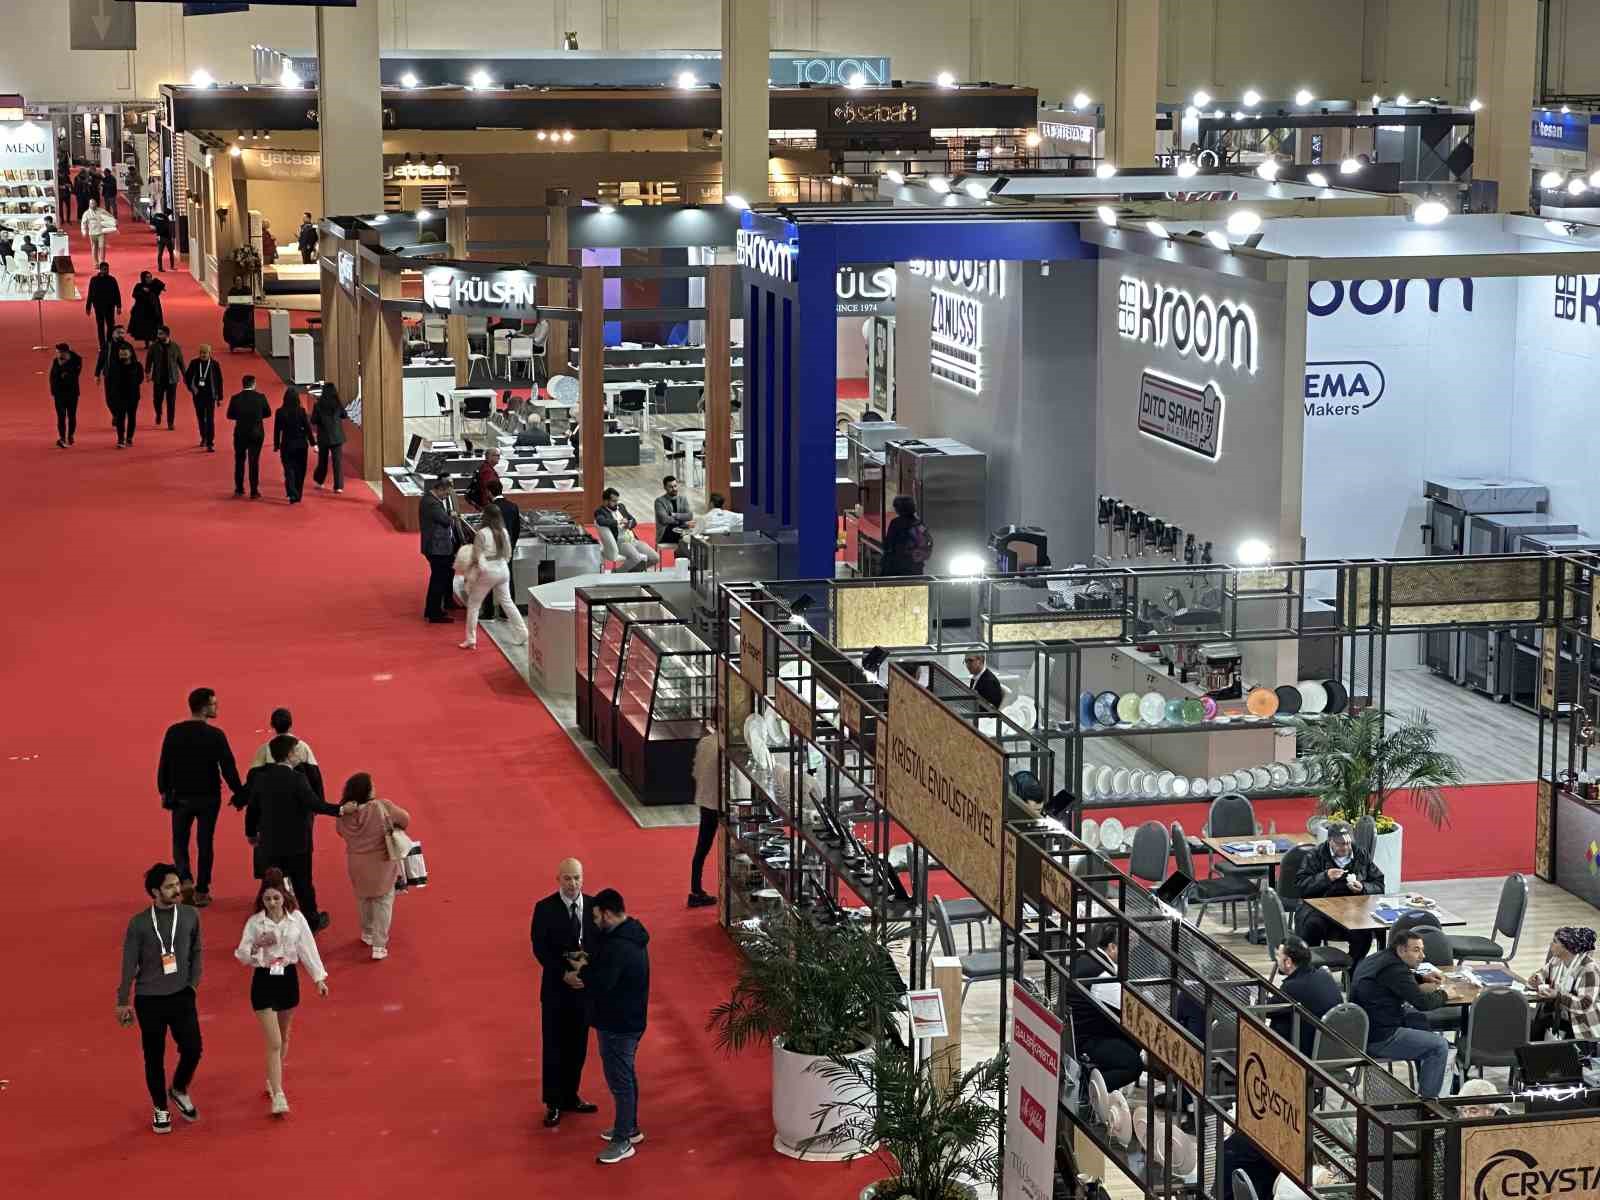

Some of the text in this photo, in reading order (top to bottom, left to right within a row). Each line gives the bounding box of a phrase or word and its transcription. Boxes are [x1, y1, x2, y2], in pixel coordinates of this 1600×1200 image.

[5, 143, 46, 154] MENU
[455, 276, 535, 305] KÜLSAN
[861, 303, 878, 312] 1974
[931, 291, 978, 347] ZANUSSI
[1142, 392, 1167, 419] DITO
[1305, 402, 1360, 417] Makers
[1253, 1075, 1300, 1135] CRYSTAL
